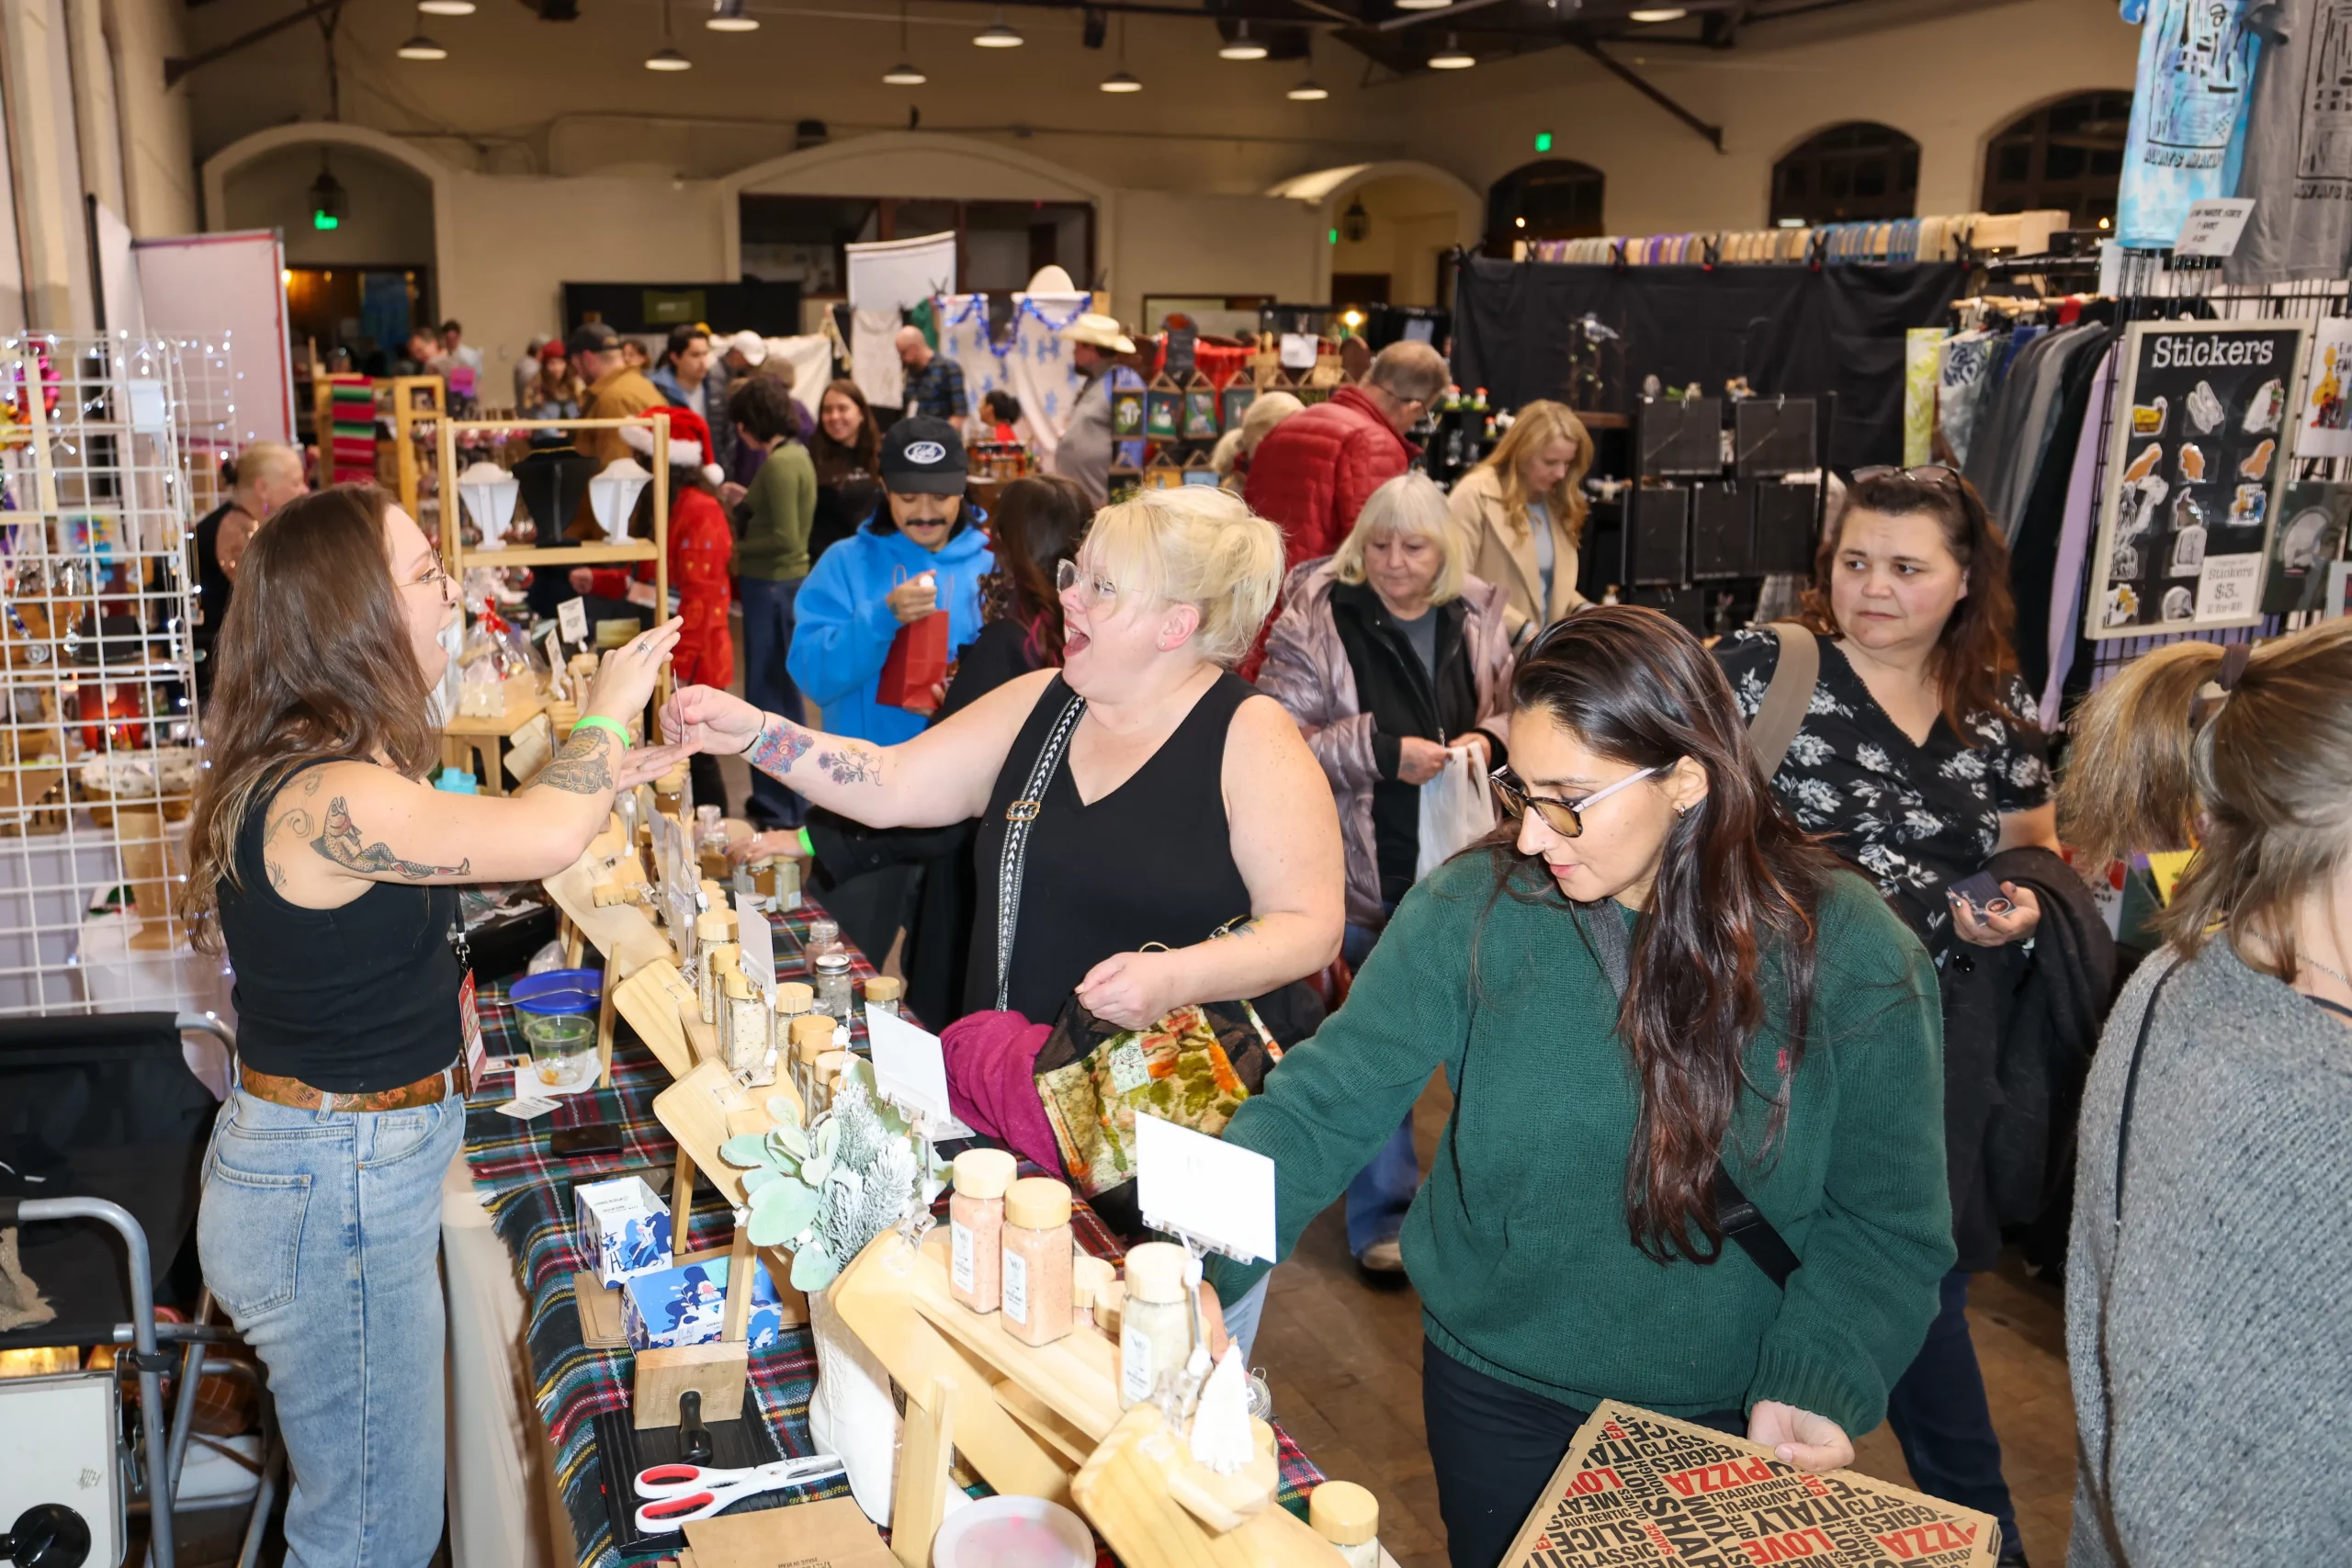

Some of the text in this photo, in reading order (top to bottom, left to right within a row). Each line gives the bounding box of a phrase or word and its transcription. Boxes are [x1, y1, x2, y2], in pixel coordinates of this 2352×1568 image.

[2151, 334, 2274, 367] Stickers
[1633, 1461, 1670, 1495] DOUGH
[1661, 1456, 1775, 1497] PIZZA
[1706, 1476, 1803, 1503] TRADITIONAL
[1617, 1488, 1649, 1520] OLIVES
[1715, 1486, 1815, 1515] FLAVORFUL
[1750, 1495, 1851, 1537] ITALY
[1564, 1507, 1632, 1529] AUTHENTIC
[1679, 1495, 1736, 1545] YUM
[1724, 1514, 1758, 1540] BITE
[1548, 1519, 1647, 1555] SLICE
[1642, 1524, 1676, 1556] SAUCE
[1739, 1528, 1835, 1565] LOVE
[1841, 1518, 1887, 1558] DOUGH
